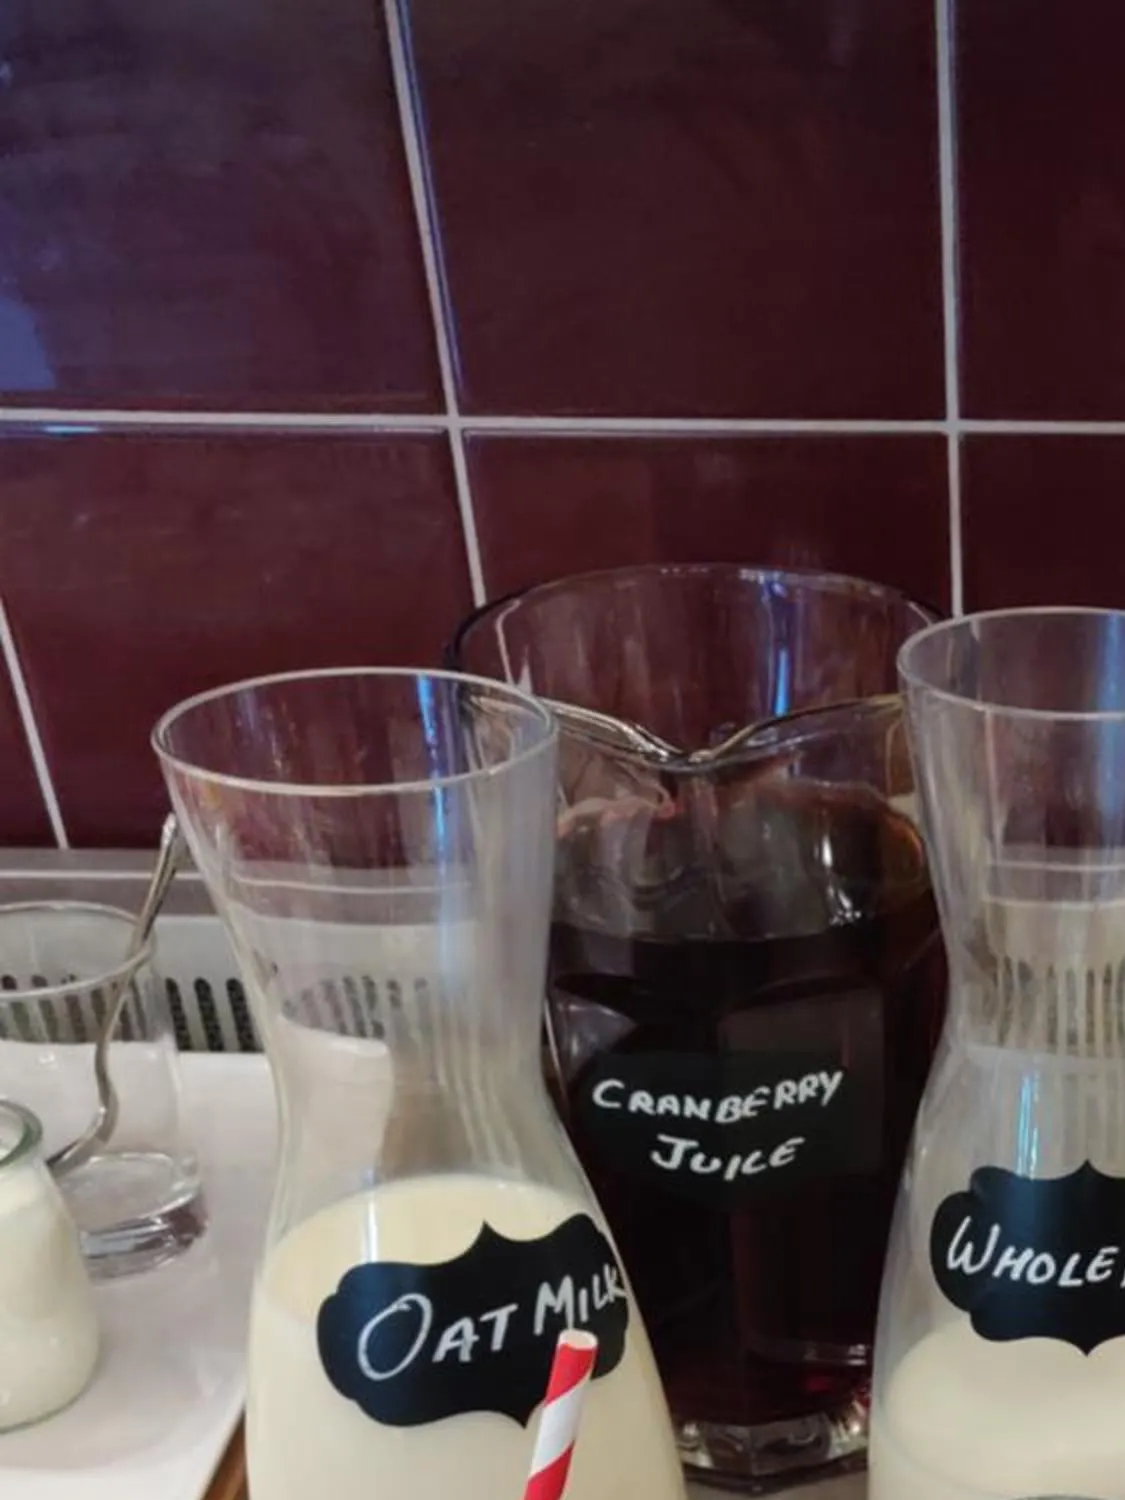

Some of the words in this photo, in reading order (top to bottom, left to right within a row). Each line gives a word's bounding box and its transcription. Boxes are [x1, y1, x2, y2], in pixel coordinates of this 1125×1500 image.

[592, 1070, 843, 1125] CRANBERRY
[650, 1134, 804, 1181] JUICE
[947, 1215, 1118, 1288] WHOLE
[357, 1292, 517, 1381] OAT
[534, 1262, 629, 1335] MILK
